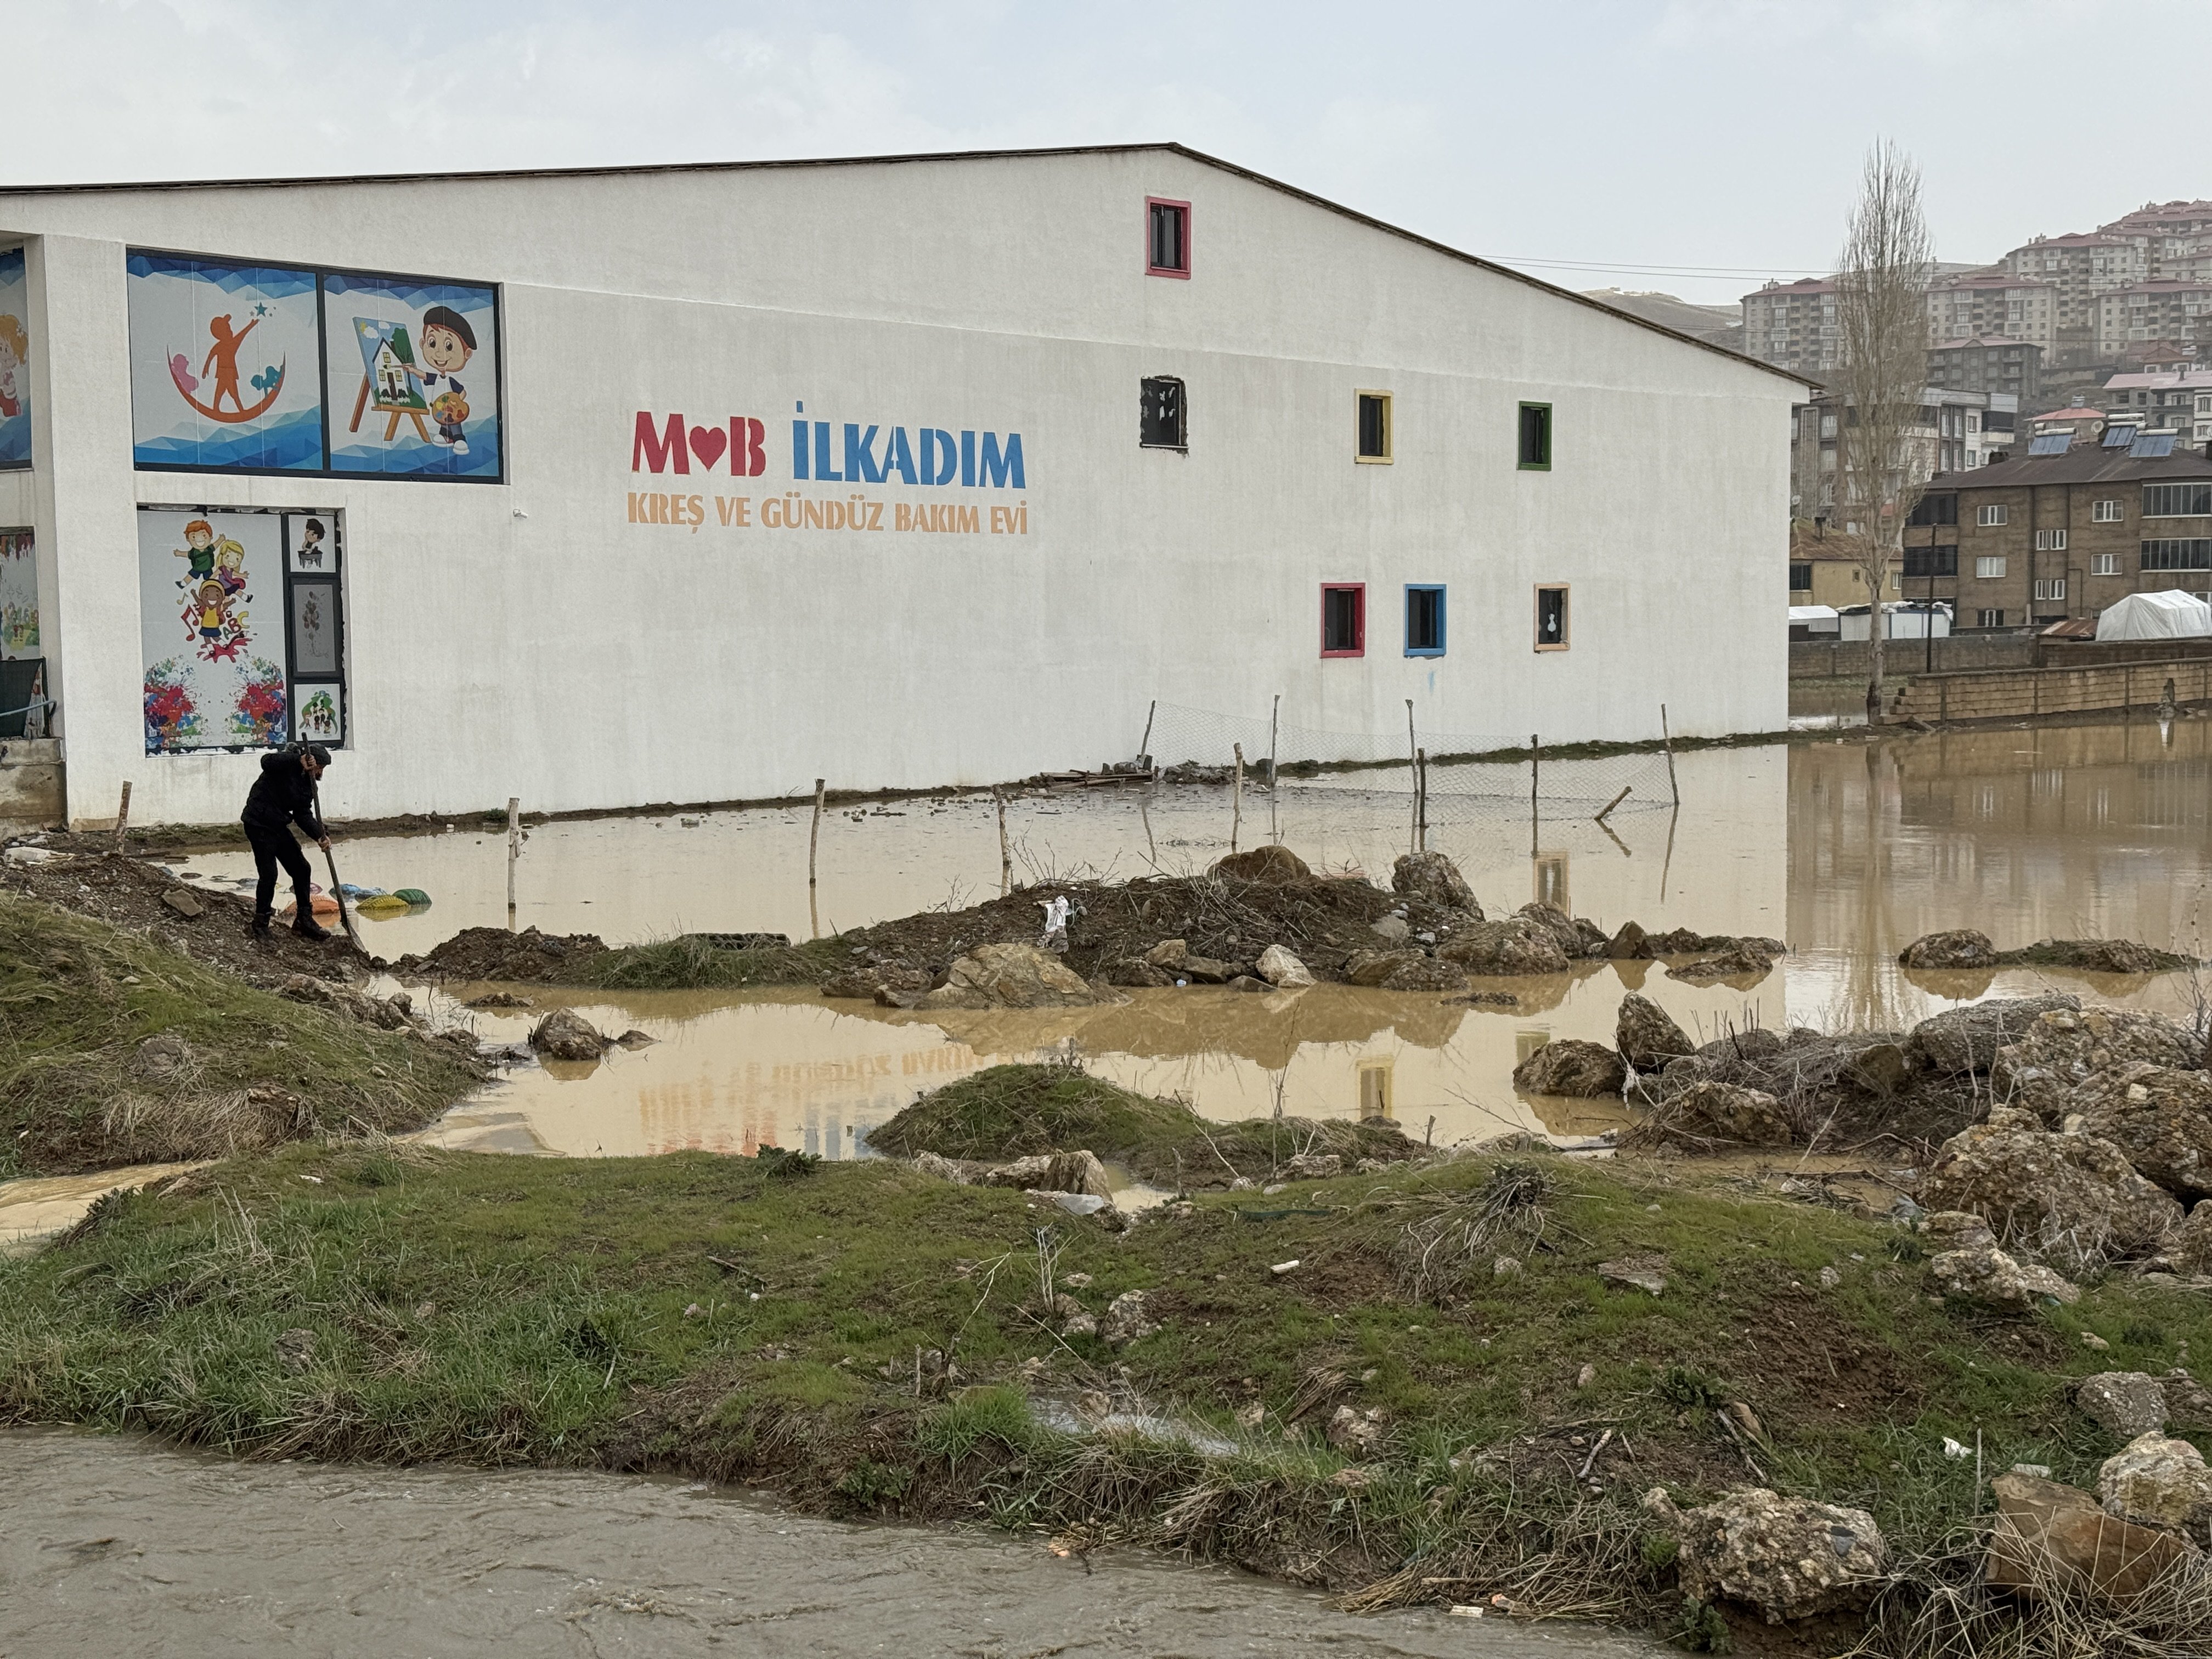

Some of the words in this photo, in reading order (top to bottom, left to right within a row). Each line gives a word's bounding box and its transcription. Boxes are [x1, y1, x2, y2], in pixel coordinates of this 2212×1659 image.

[793, 401, 1025, 489] İLKADIM
[628, 492, 704, 534] KREŞ
[715, 496, 751, 527] VE
[761, 492, 884, 531] GÜNDÜZ
[895, 503, 980, 533] BAKIM
[990, 500, 1028, 534] EVİ
